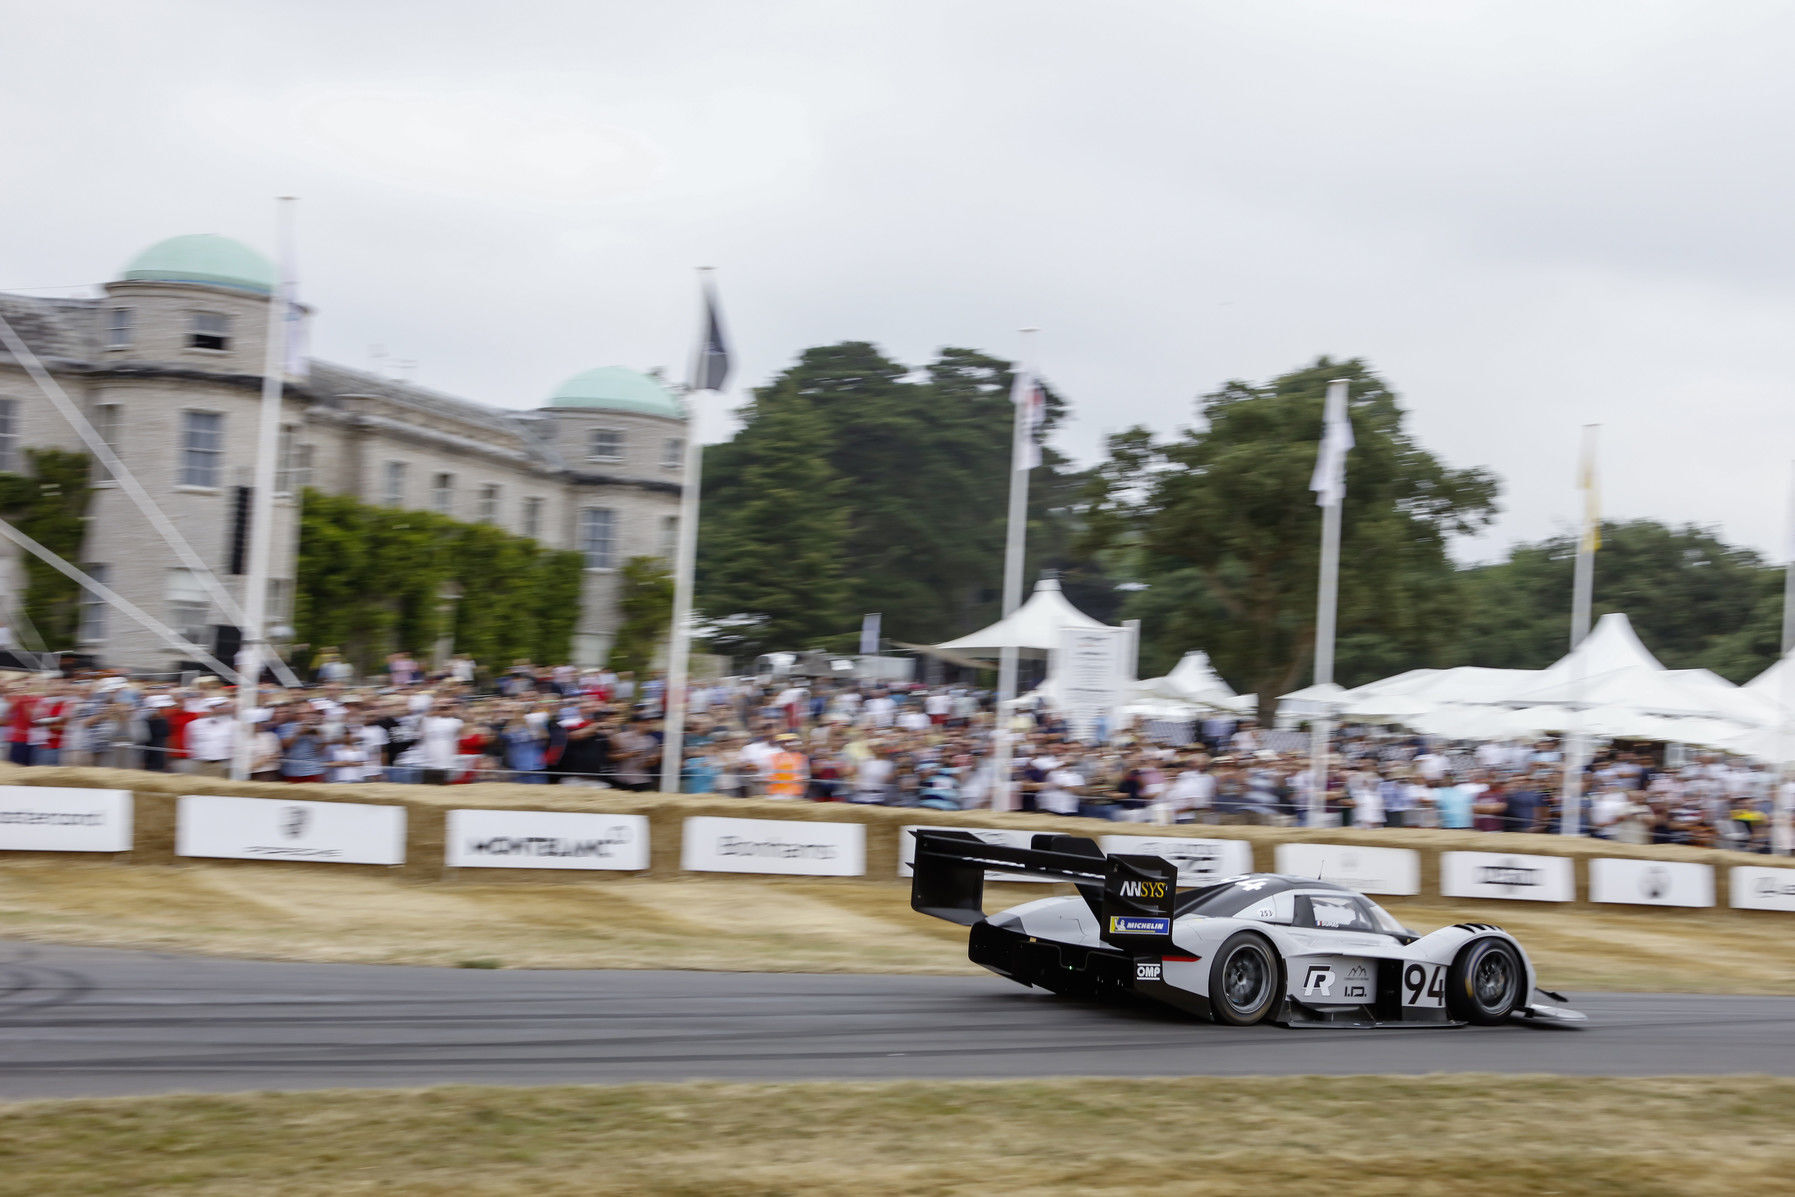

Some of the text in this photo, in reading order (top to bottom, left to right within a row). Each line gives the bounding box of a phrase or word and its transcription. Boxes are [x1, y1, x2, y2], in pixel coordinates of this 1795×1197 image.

[1120, 880, 1166, 898] ANSYS
[1126, 922, 1164, 930] MICHELIN
[1136, 966, 1161, 977] OMP
[1404, 963, 1445, 1006] 94
